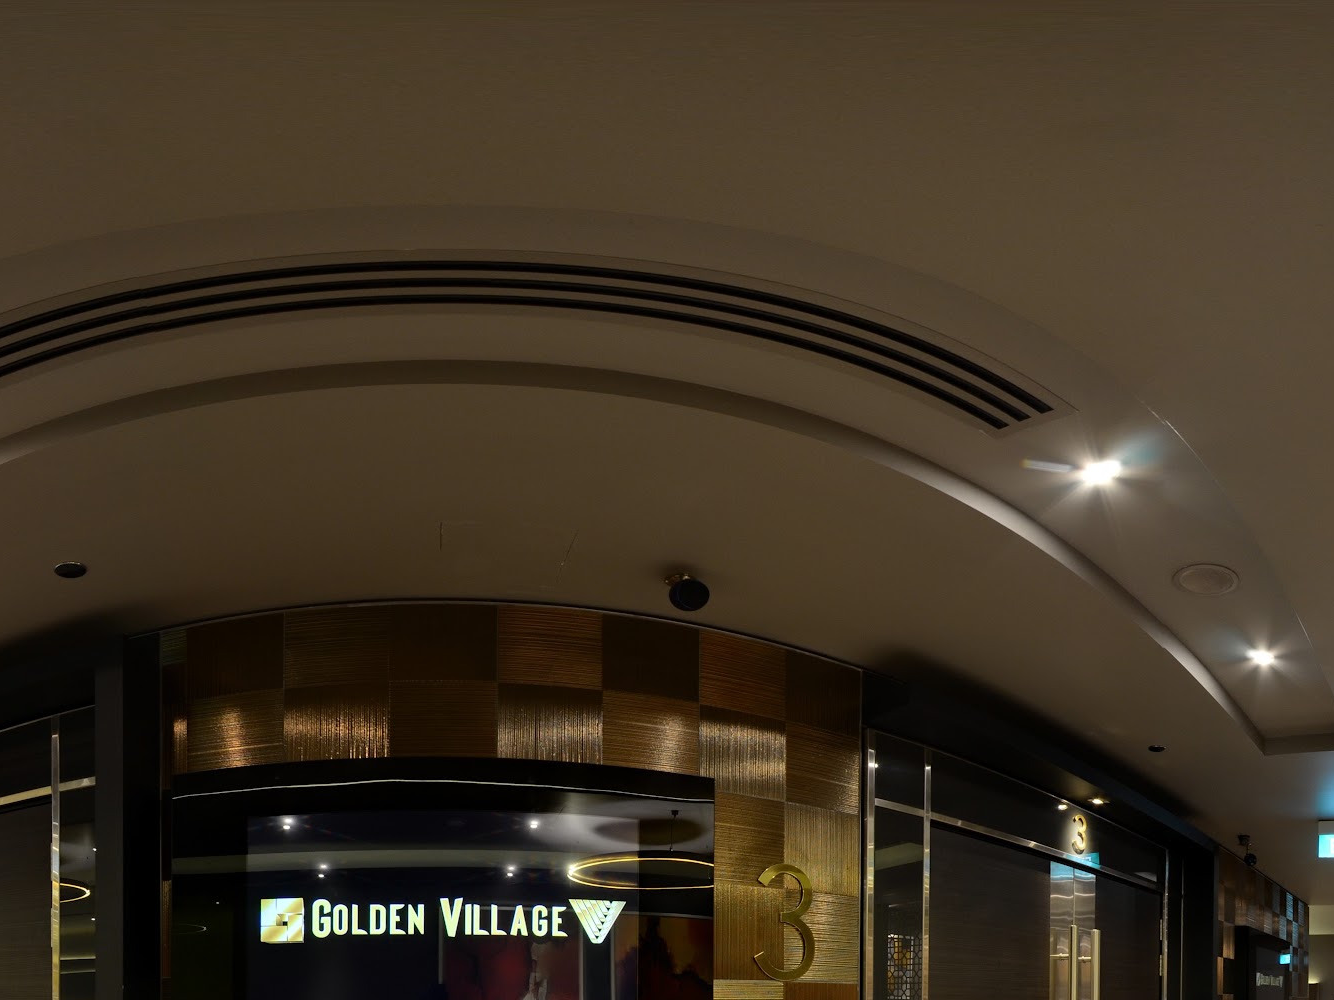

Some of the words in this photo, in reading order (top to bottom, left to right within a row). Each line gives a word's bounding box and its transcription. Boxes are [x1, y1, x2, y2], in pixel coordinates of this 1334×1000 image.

[1072, 814, 1087, 855] 3
[312, 898, 425, 939] GOLDEN
[440, 897, 568, 937] VILLAGE
[753, 863, 816, 982] 3
